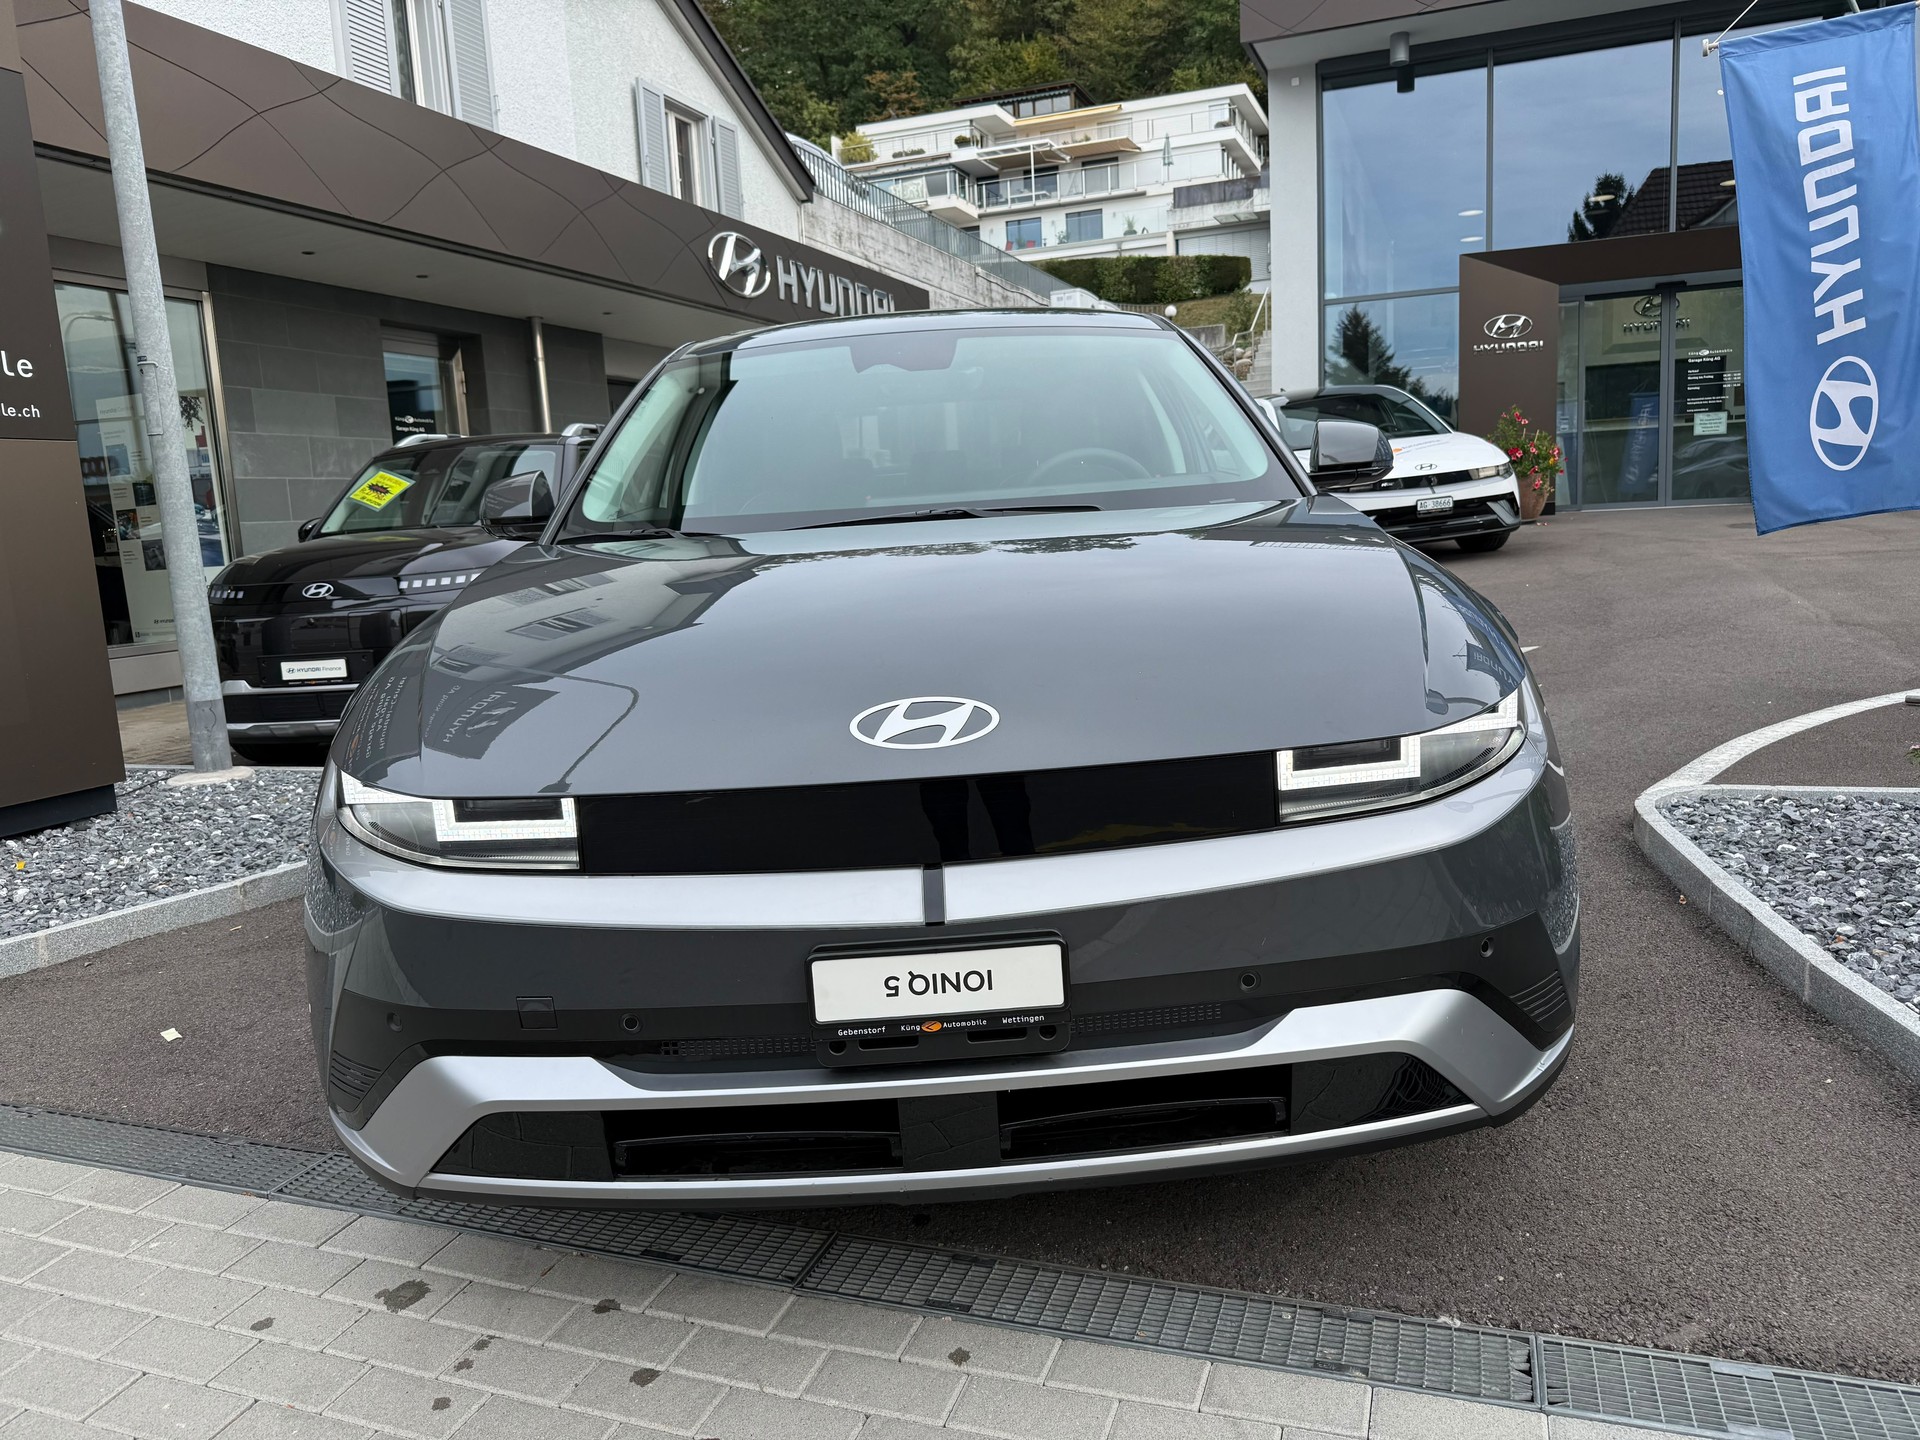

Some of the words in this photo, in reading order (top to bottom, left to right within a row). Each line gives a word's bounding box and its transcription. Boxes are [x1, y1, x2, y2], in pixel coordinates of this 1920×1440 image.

[1793, 66, 1866, 346] HYUNDAI
[1623, 317, 1691, 333] HYUNAI
[1473, 340, 1544, 355] HYUNDAI
[0, 350, 33, 378] le
[0, 402, 41, 418] le.ch
[883, 975, 900, 998] 5
[908, 969, 993, 996] IONIQ
[838, 1026, 886, 1036] Gebenstorf
[901, 1024, 921, 1032] Küng
[943, 1019, 987, 1028] Automobile
[1002, 1014, 1045, 1024] Wettingen
